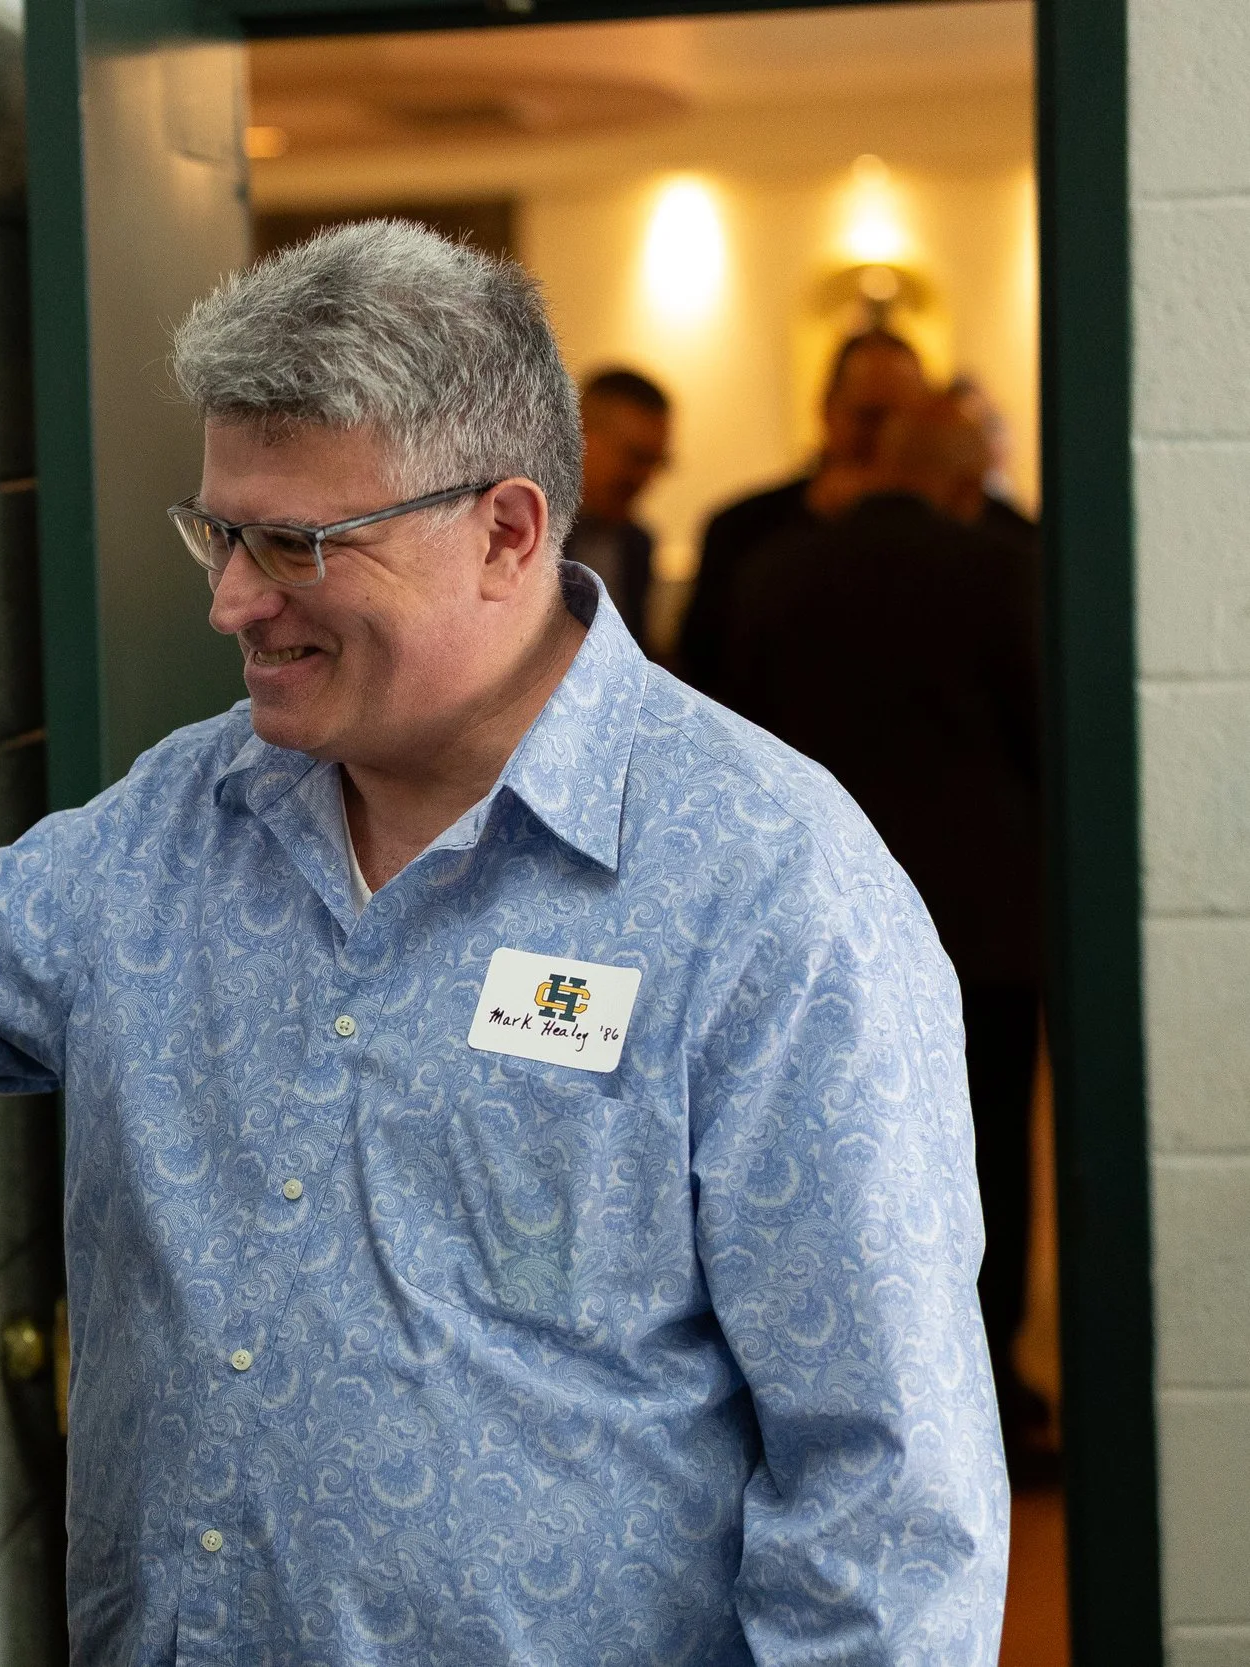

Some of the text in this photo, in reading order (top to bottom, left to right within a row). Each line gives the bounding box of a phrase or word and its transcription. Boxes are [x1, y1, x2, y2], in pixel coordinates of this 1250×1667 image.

[488, 1007, 619, 1052] Mark Healey '86
